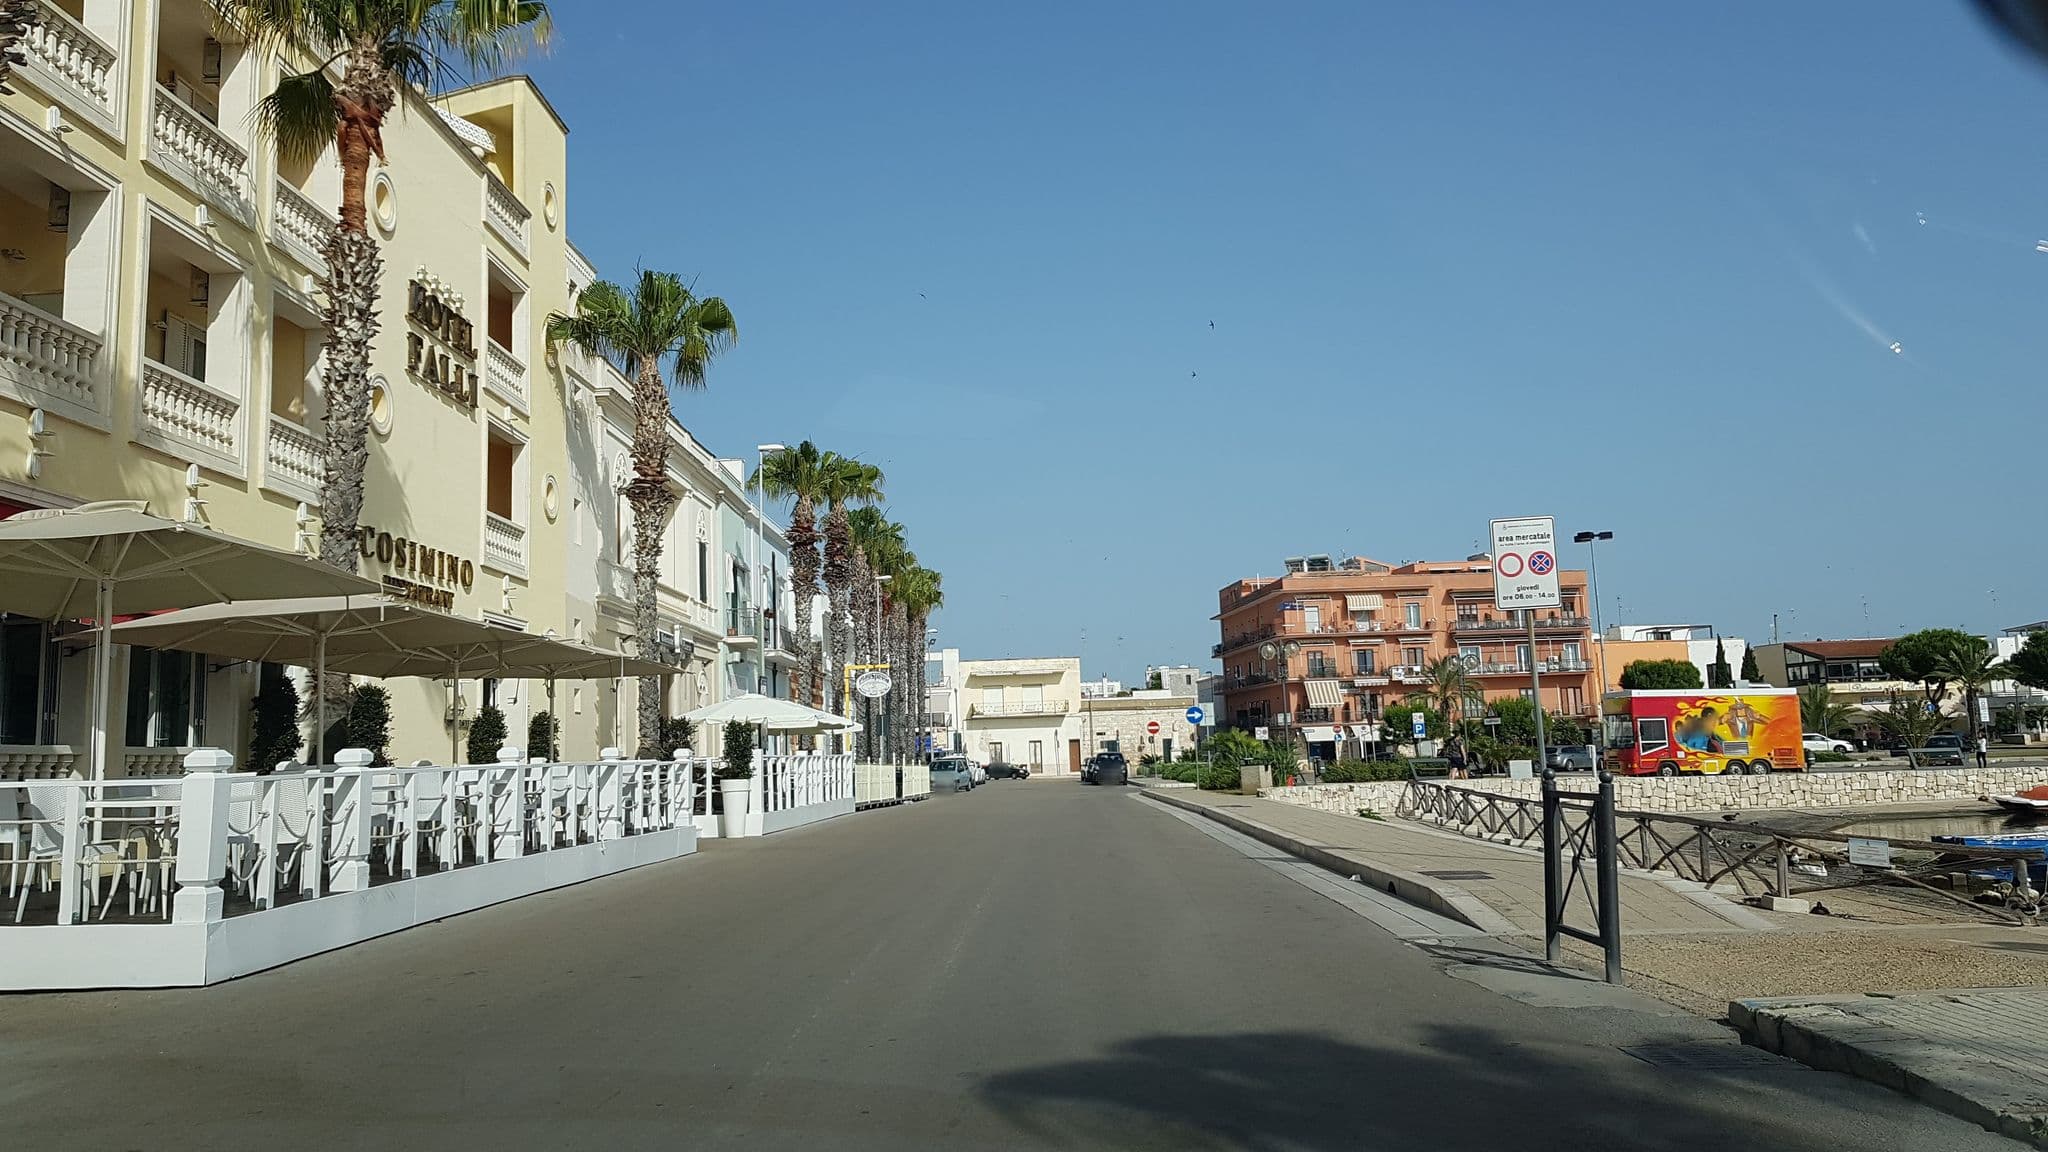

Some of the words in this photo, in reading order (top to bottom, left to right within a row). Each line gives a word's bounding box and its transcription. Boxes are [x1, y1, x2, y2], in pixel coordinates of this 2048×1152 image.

[406, 279, 478, 361] HOTEL
[405, 331, 479, 408] FALLI
[359, 526, 473, 588] COSIMINO
[1515, 532, 1551, 541] mercatale
[1415, 724, 1422, 734] P
